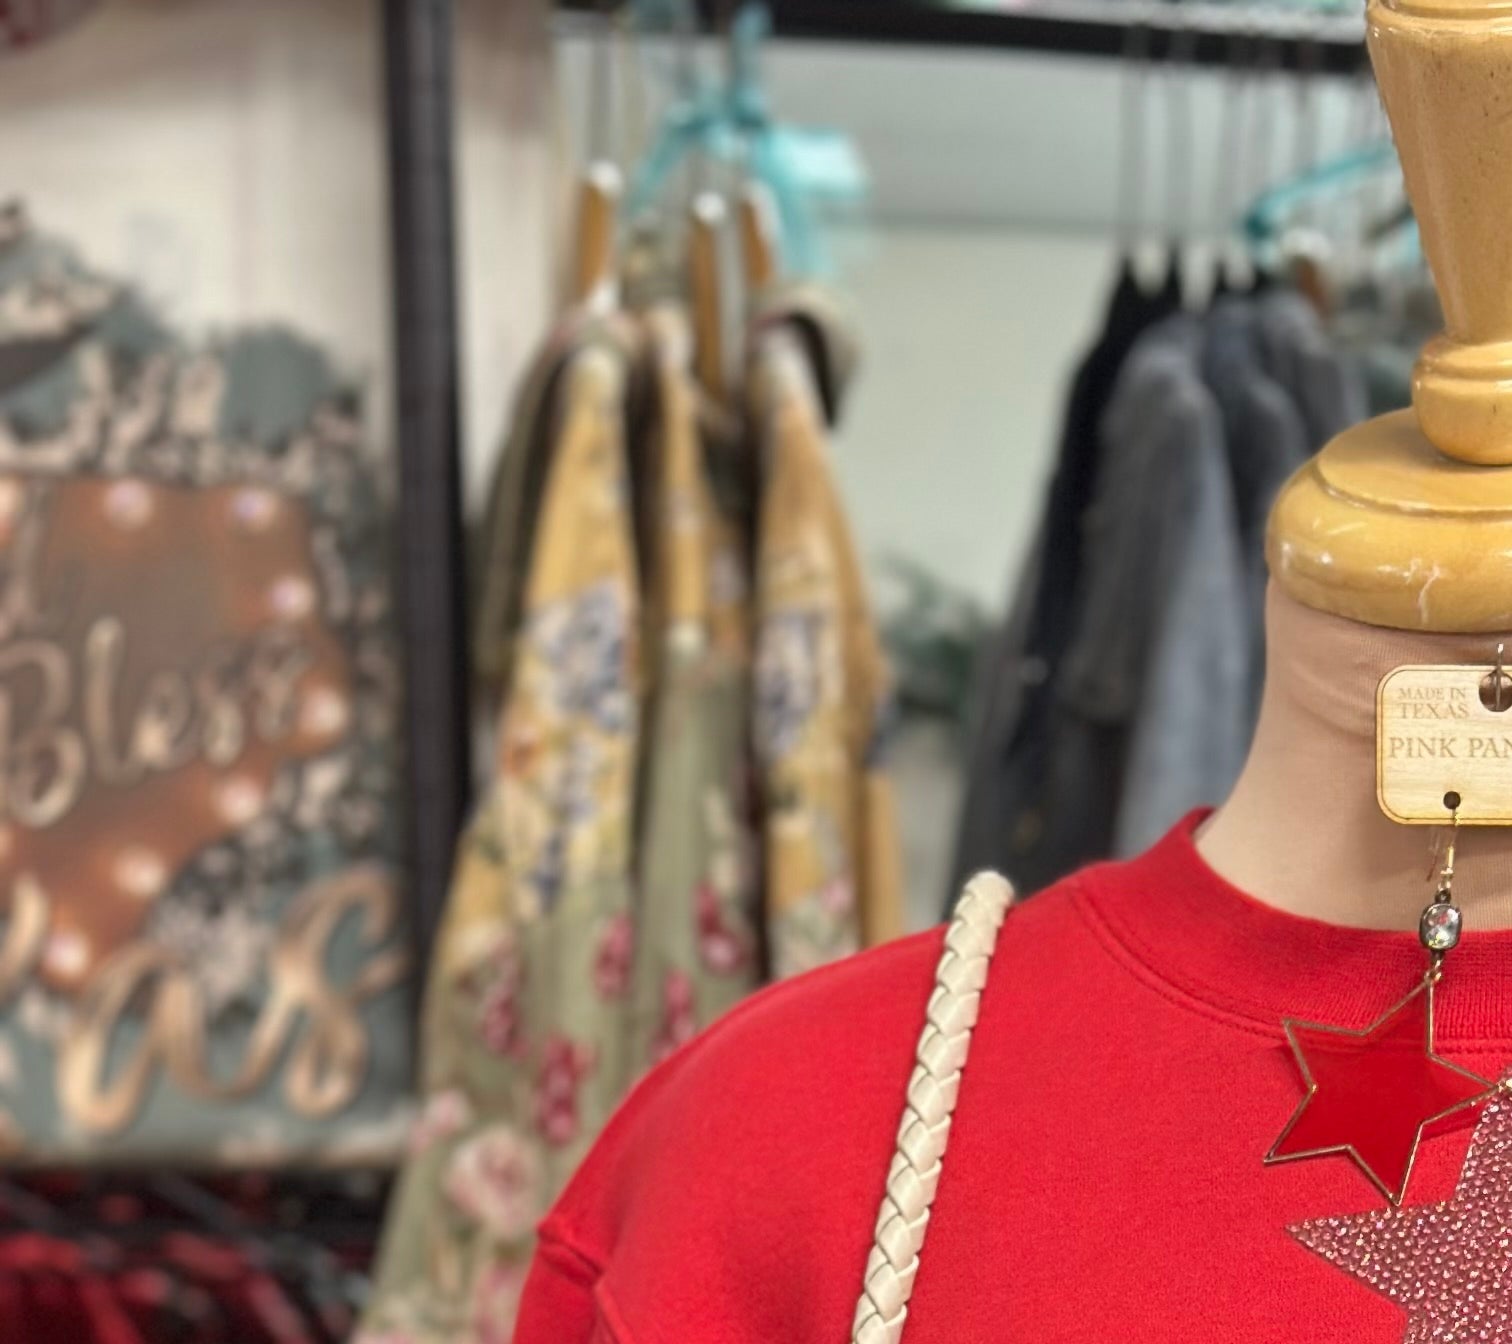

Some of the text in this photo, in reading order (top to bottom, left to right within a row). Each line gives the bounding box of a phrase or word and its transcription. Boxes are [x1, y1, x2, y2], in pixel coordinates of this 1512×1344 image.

[1398, 687, 1466, 700] MADE IN
[1398, 702, 1470, 719] TEXAS
[1389, 737, 1458, 759] PINK
